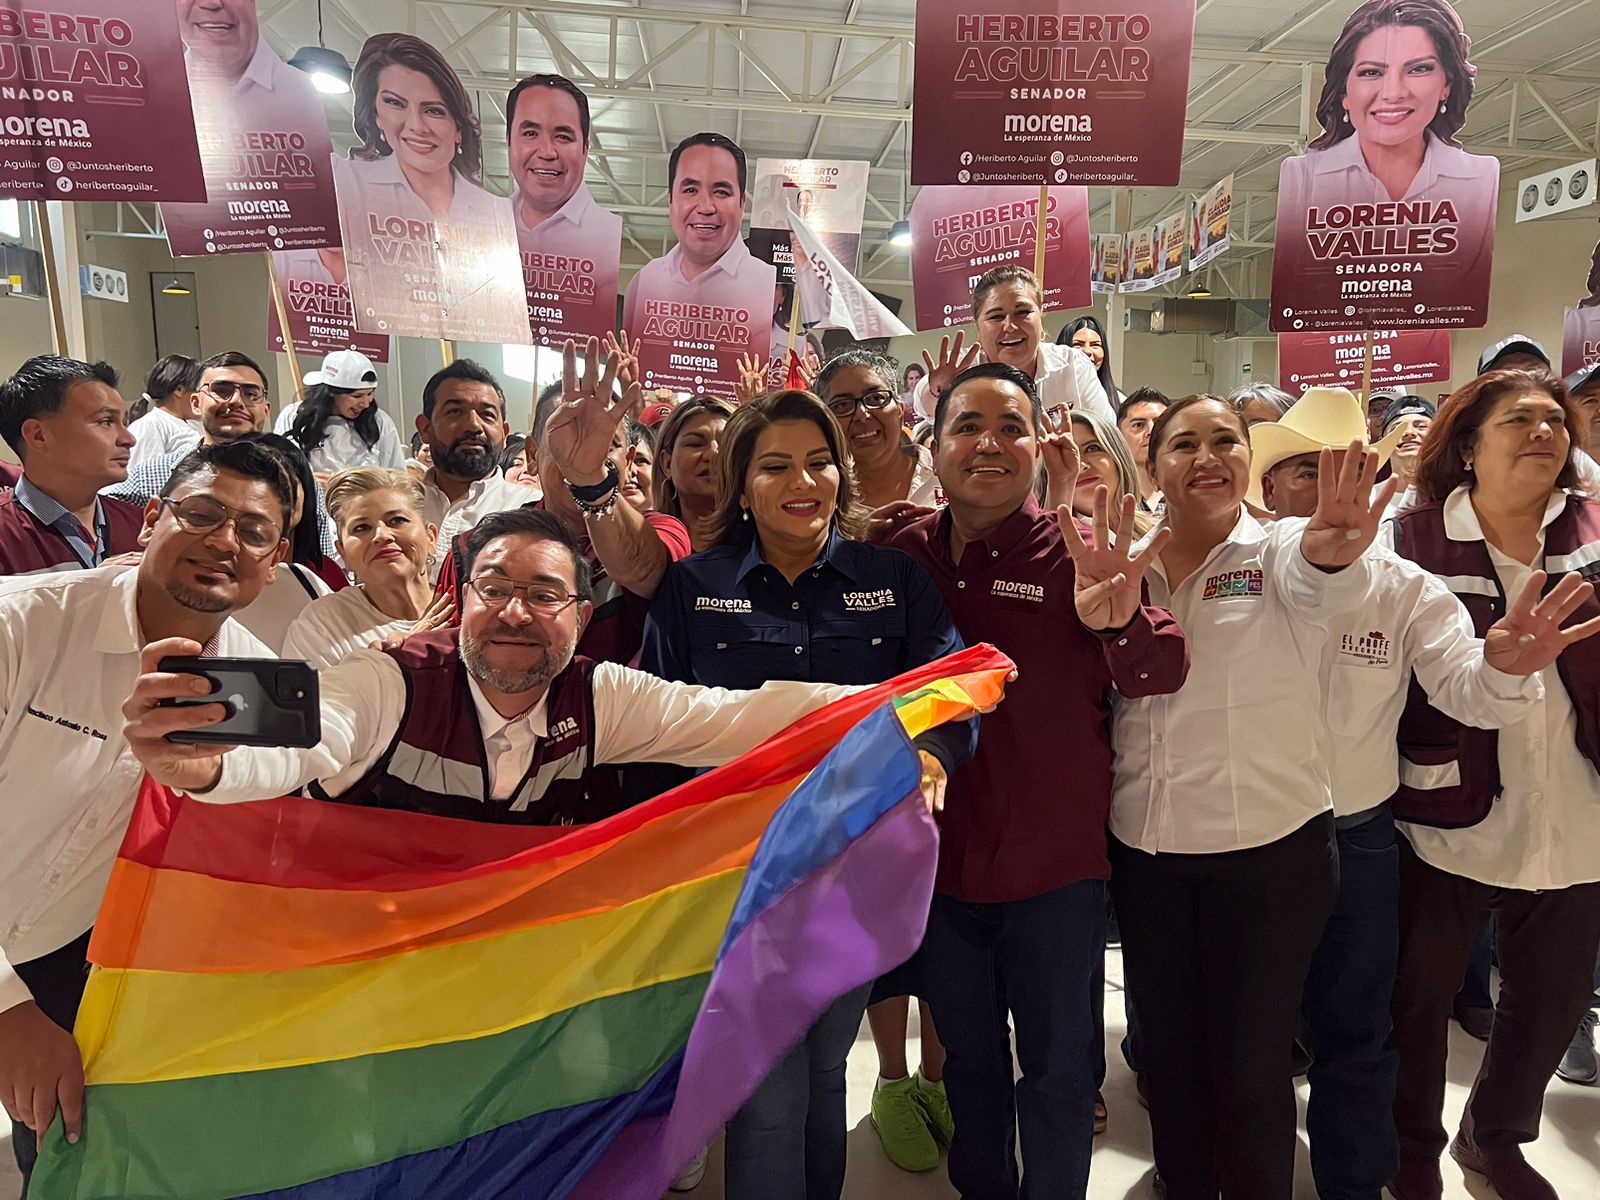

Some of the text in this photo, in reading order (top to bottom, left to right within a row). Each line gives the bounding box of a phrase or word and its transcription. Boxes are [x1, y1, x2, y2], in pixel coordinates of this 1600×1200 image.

[957, 14, 1151, 42] HERIBERTO
[954, 47, 1149, 82] AGUILAR
[1010, 88, 1087, 100] SENADOR
[0, 114, 91, 137] orena
[1004, 114, 1093, 133] morena
[44, 138, 57, 147] de
[58, 139, 92, 148] México
[1004, 133, 1092, 144] La esperanza de México
[4, 159, 154, 172] Aguilar @Juntosheriberto
[975, 153, 1139, 166] /Heriberto Aguilar @Juntosheriberto
[225, 181, 280, 191] SENADOR
[227, 199, 290, 215] morena
[1306, 199, 1459, 230] LORENIA
[772, 243, 789, 253] Más
[1305, 226, 1459, 260] VALLES
[521, 251, 596, 275] IBERTO
[969, 251, 1020, 267] SENADOR
[1335, 262, 1423, 275] SENADORA
[1341, 279, 1413, 293] morena
[644, 299, 751, 325] HERIBERTO
[306, 315, 356, 328] SENADORA
[1372, 317, 1465, 326] www.loreniavalles.mx
[309, 325, 349, 338] morena
[643, 316, 750, 345] AGUILAR
[673, 340, 716, 351] SENADOR
[669, 353, 718, 369] morena
[1206, 569, 1264, 587] morena
[842, 588, 893, 600] LORENIA
[993, 579, 1045, 597] morena
[696, 596, 752, 609] morena
[844, 595, 895, 608] VALLES
[1342, 634, 1353, 645] EL
[82, 726, 90, 735] C.
